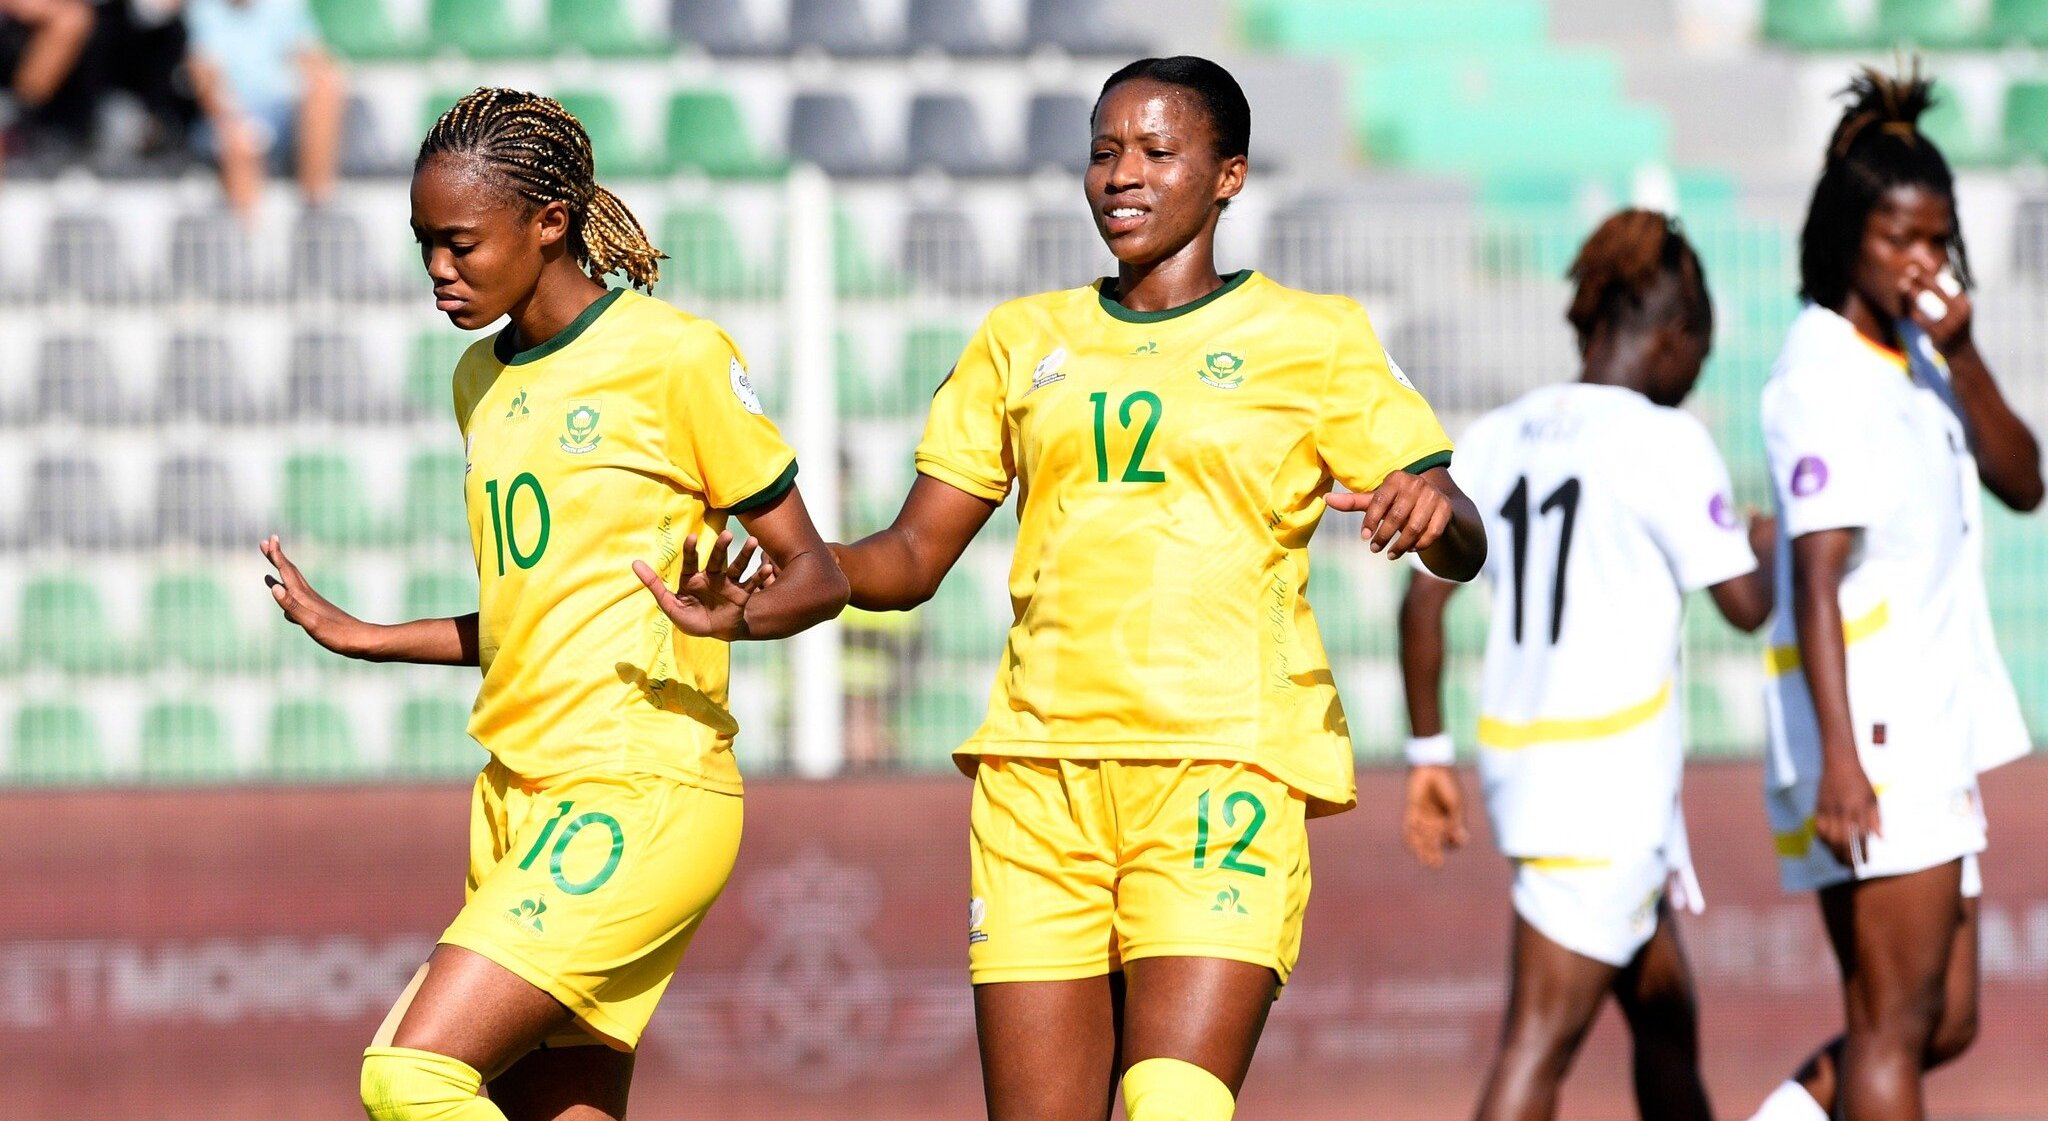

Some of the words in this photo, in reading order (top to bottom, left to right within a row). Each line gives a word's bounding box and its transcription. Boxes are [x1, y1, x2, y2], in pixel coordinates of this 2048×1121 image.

[1089, 390, 1166, 484] 12
[485, 472, 551, 576] 10
[1498, 474, 1582, 647] 11
[519, 800, 625, 895] 10
[1193, 790, 1267, 877] 12
